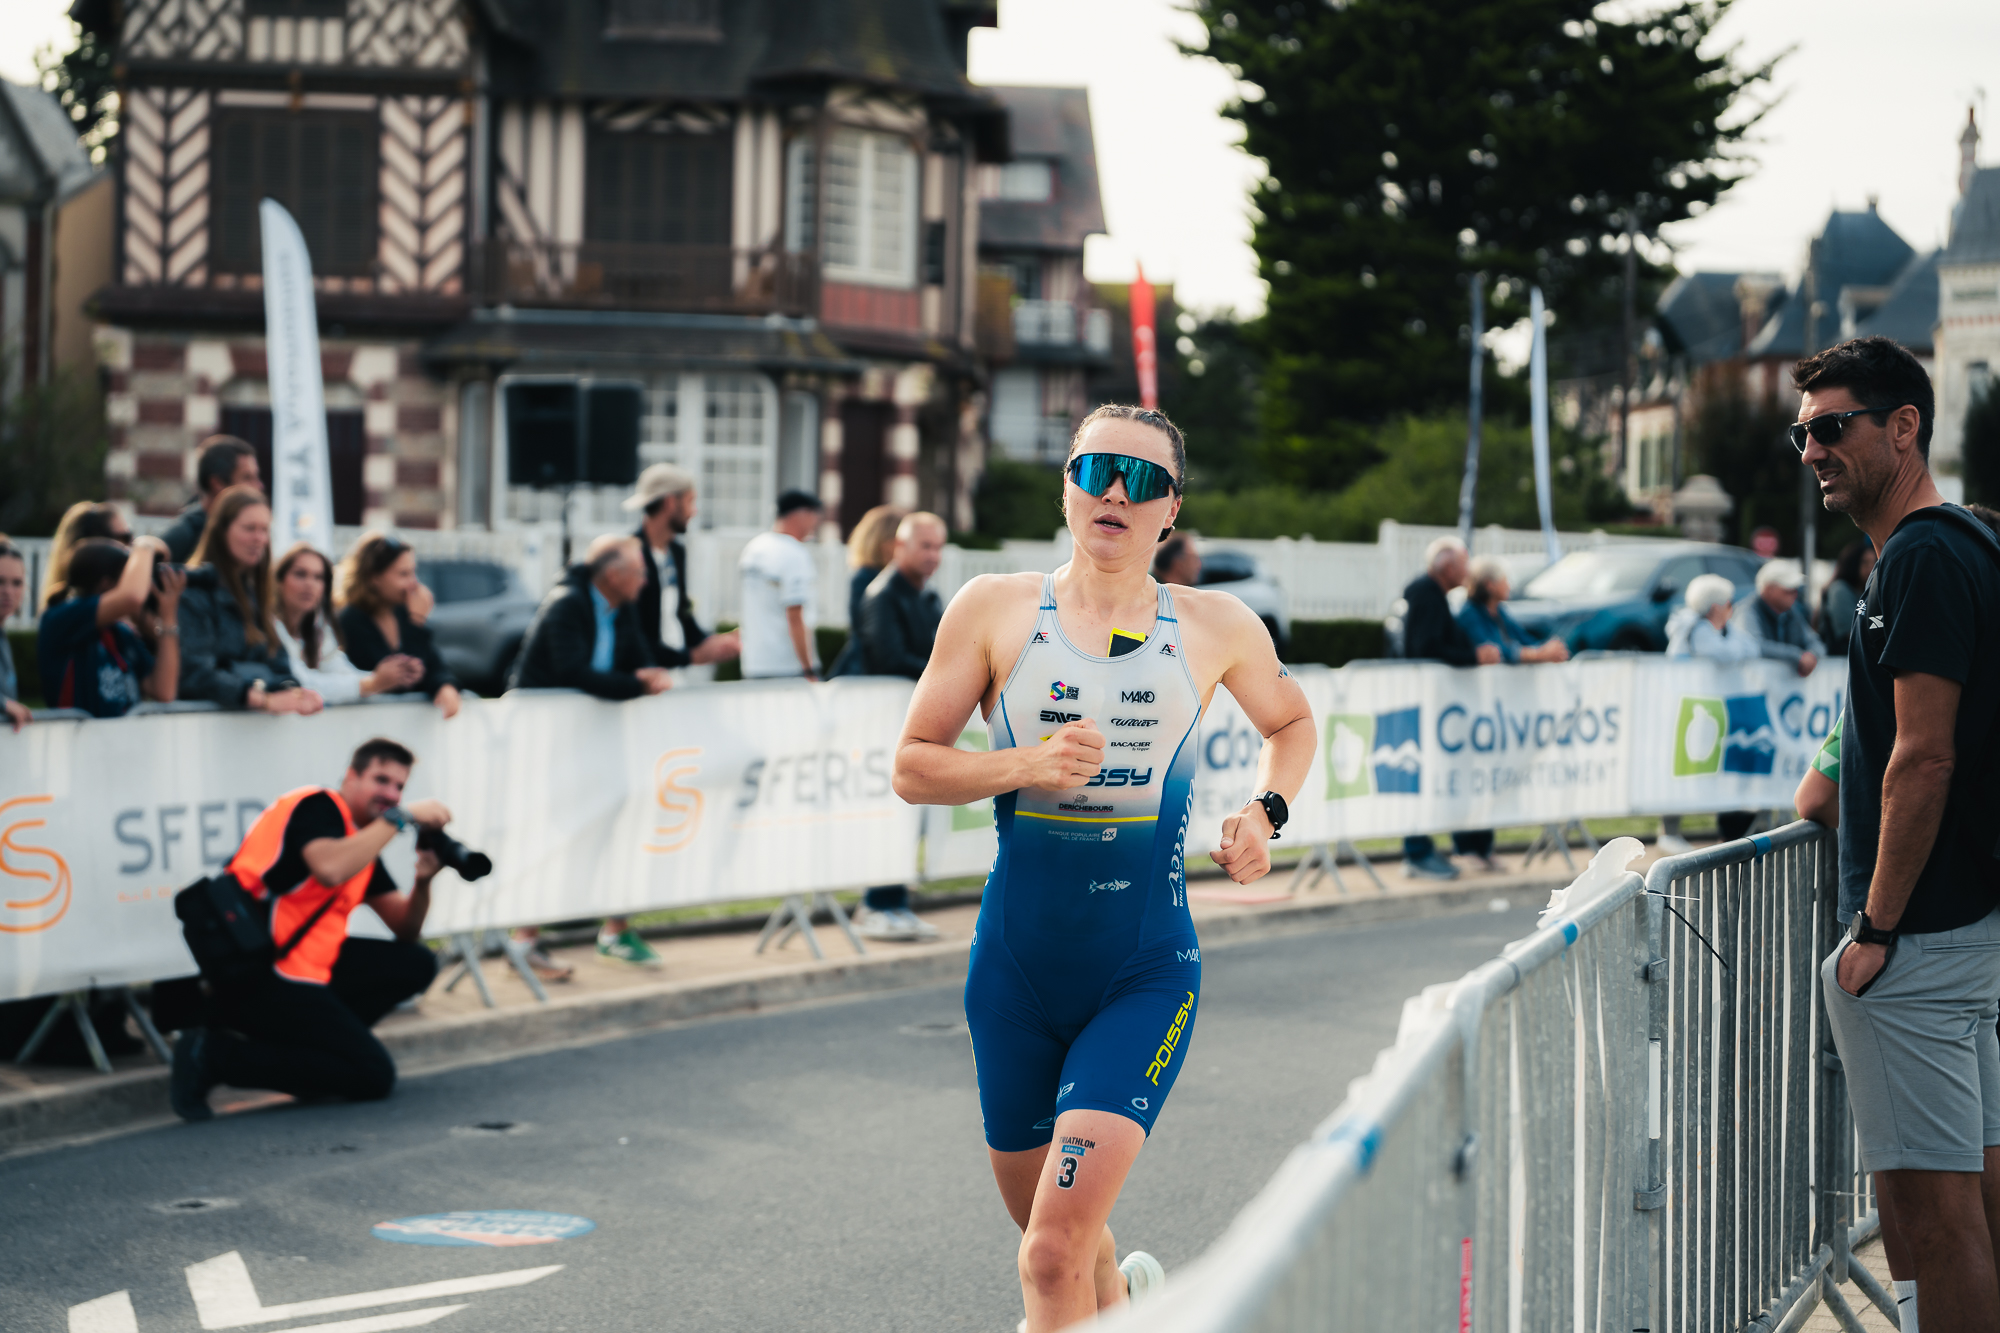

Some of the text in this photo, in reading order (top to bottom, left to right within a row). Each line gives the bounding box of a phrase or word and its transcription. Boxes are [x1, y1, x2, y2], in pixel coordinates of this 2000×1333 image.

[1121, 690, 1155, 703] MAKO
[1437, 694, 1620, 755] Calvados
[1084, 768, 1152, 787] SSY
[1058, 803, 1114, 812] DERICHEBOURG
[1145, 991, 1194, 1086] POISSY
[1056, 1156, 1078, 1188] 3
